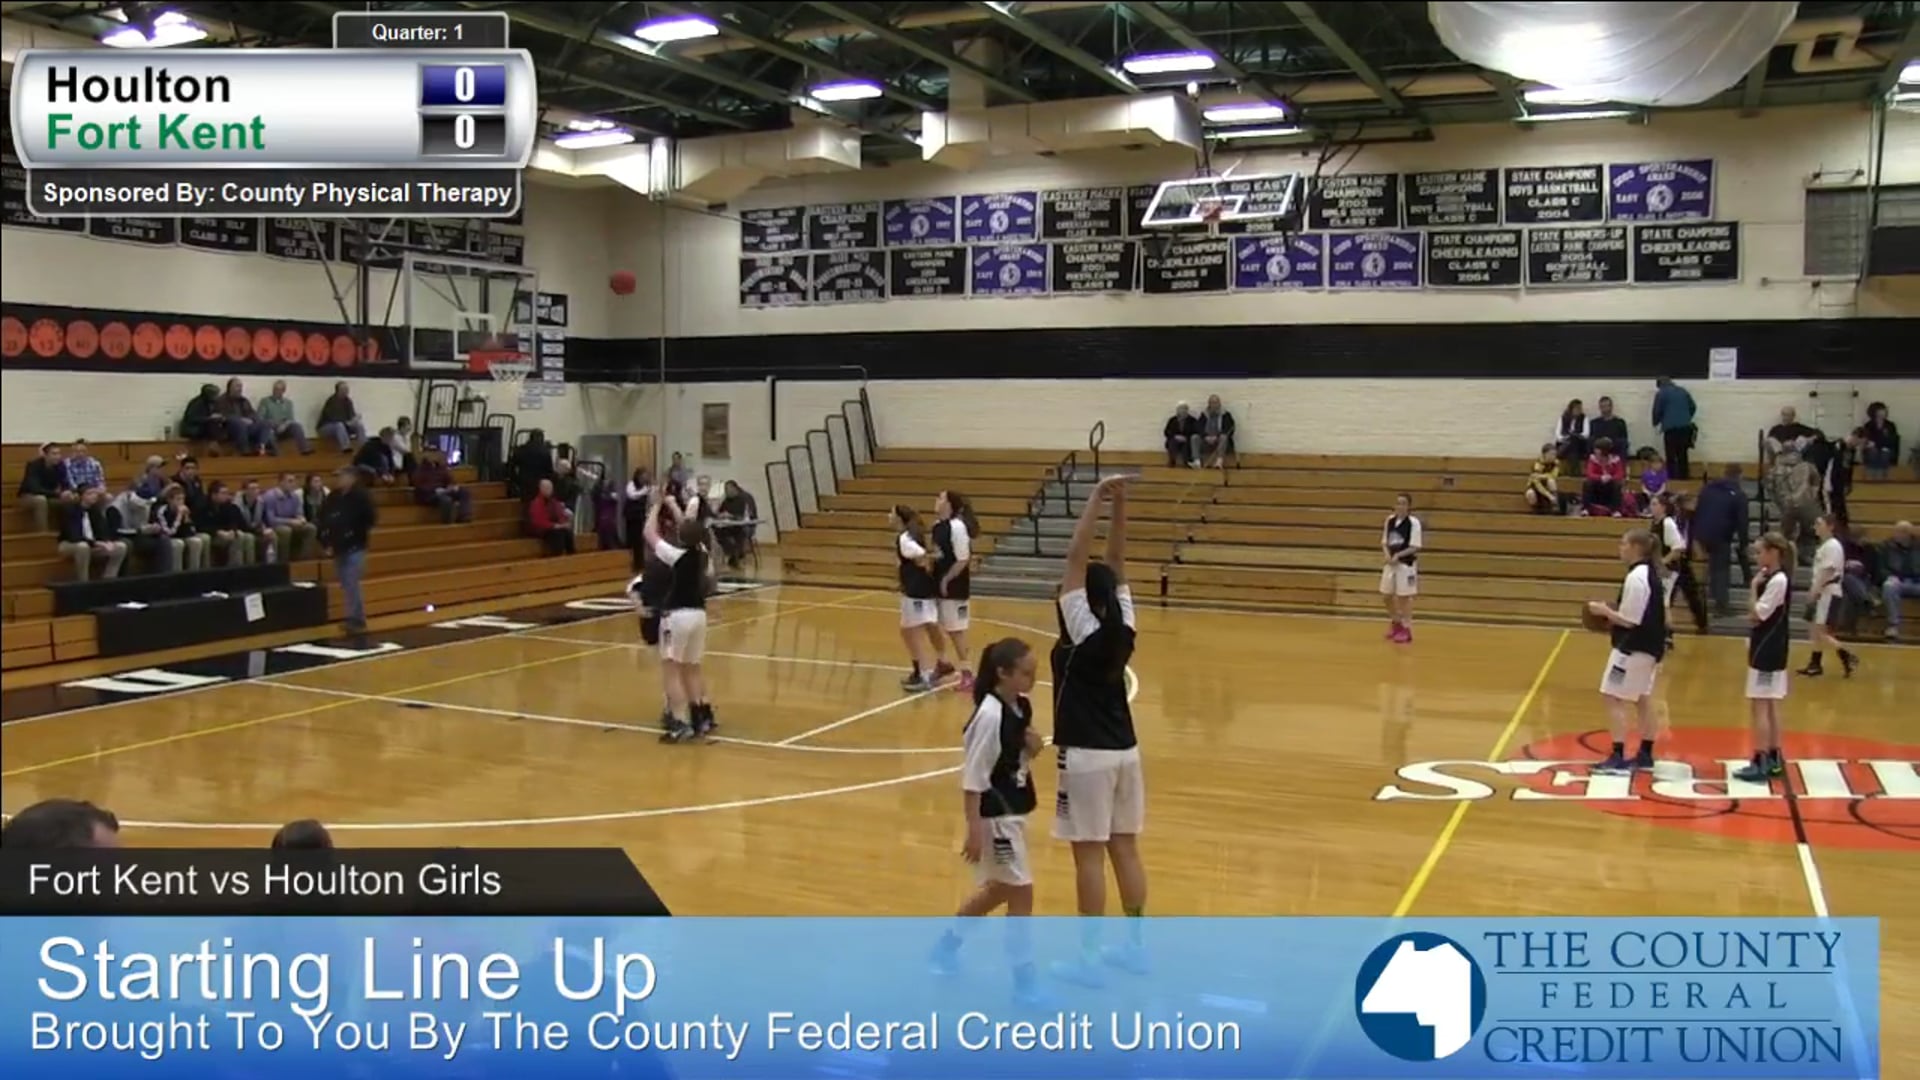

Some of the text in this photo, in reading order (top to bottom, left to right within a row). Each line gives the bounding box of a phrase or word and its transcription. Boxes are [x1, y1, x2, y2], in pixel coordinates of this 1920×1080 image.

[1511, 169, 1597, 182] STATE CHAMPIONS
[1322, 187, 1383, 199] CHAMPIONS
[1508, 182, 1599, 197] BOYS BASKETBALL
[1528, 197, 1581, 208] CLASS C
[1531, 232, 1560, 242] STATE
[1641, 226, 1730, 240] STATE CHAMPIONS
[1433, 233, 1516, 246] STATE CHAMPIONS
[1431, 246, 1519, 259] CHEERLEADING
[1640, 240, 1732, 254] CHEERLEADING
[1065, 252, 1121, 264] CHAMPIONS
[1658, 255, 1699, 265] CLASS
[1448, 261, 1489, 271] CLASS
